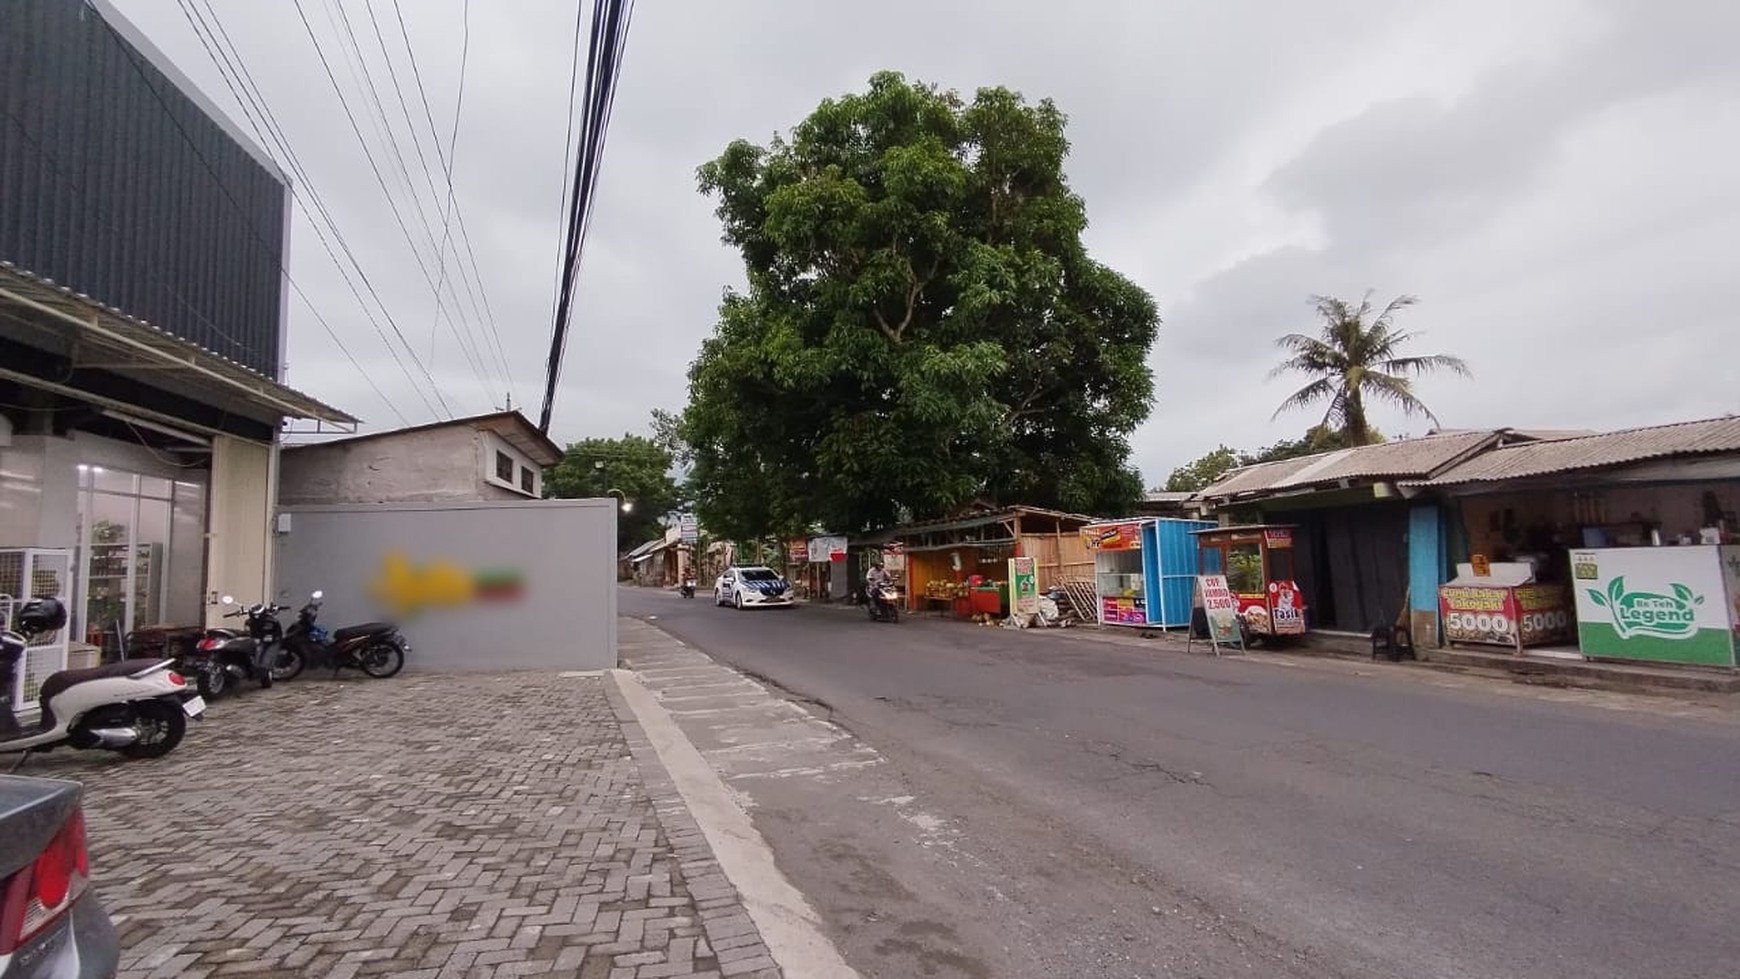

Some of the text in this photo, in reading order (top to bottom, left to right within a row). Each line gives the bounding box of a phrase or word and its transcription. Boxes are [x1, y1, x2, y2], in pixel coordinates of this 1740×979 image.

[1449, 612, 1508, 633] 5000
[1523, 611, 1567, 633] 5000
[1620, 607, 1695, 623] Legend
